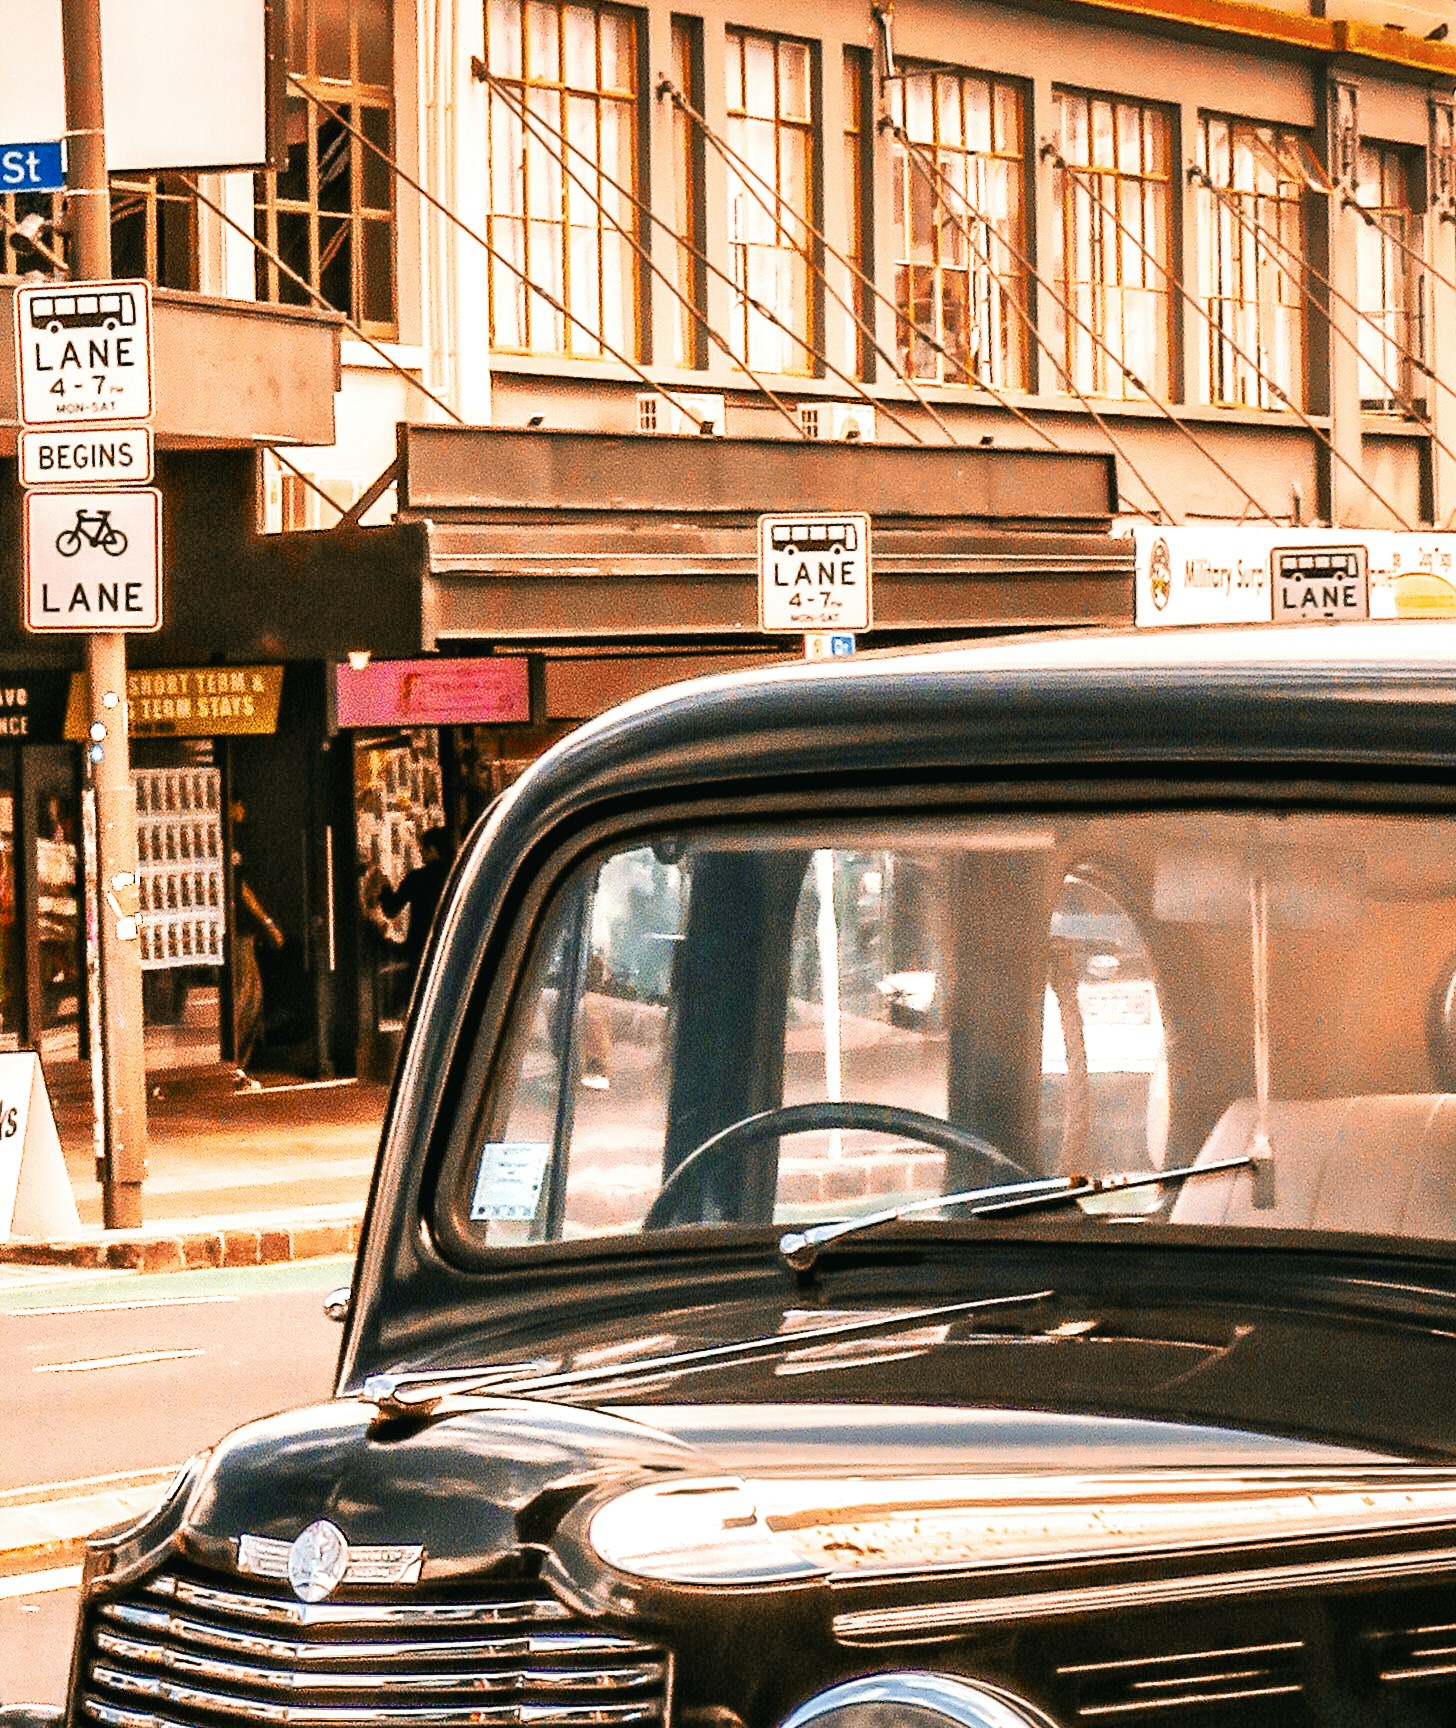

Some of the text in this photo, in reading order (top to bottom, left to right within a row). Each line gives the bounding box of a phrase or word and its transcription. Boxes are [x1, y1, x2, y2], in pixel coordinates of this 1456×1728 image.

[1, 150, 43, 184] St
[34, 337, 135, 372] LANE
[38, 442, 134, 470] BEGINS
[773, 560, 857, 587] LANE
[41, 582, 144, 613] LANE
[1282, 584, 1358, 610] LANE
[129, 674, 188, 696] SHORT
[196, 672, 245, 694] TERM
[142, 697, 192, 720] TERM
[197, 695, 255, 718] STAYS
